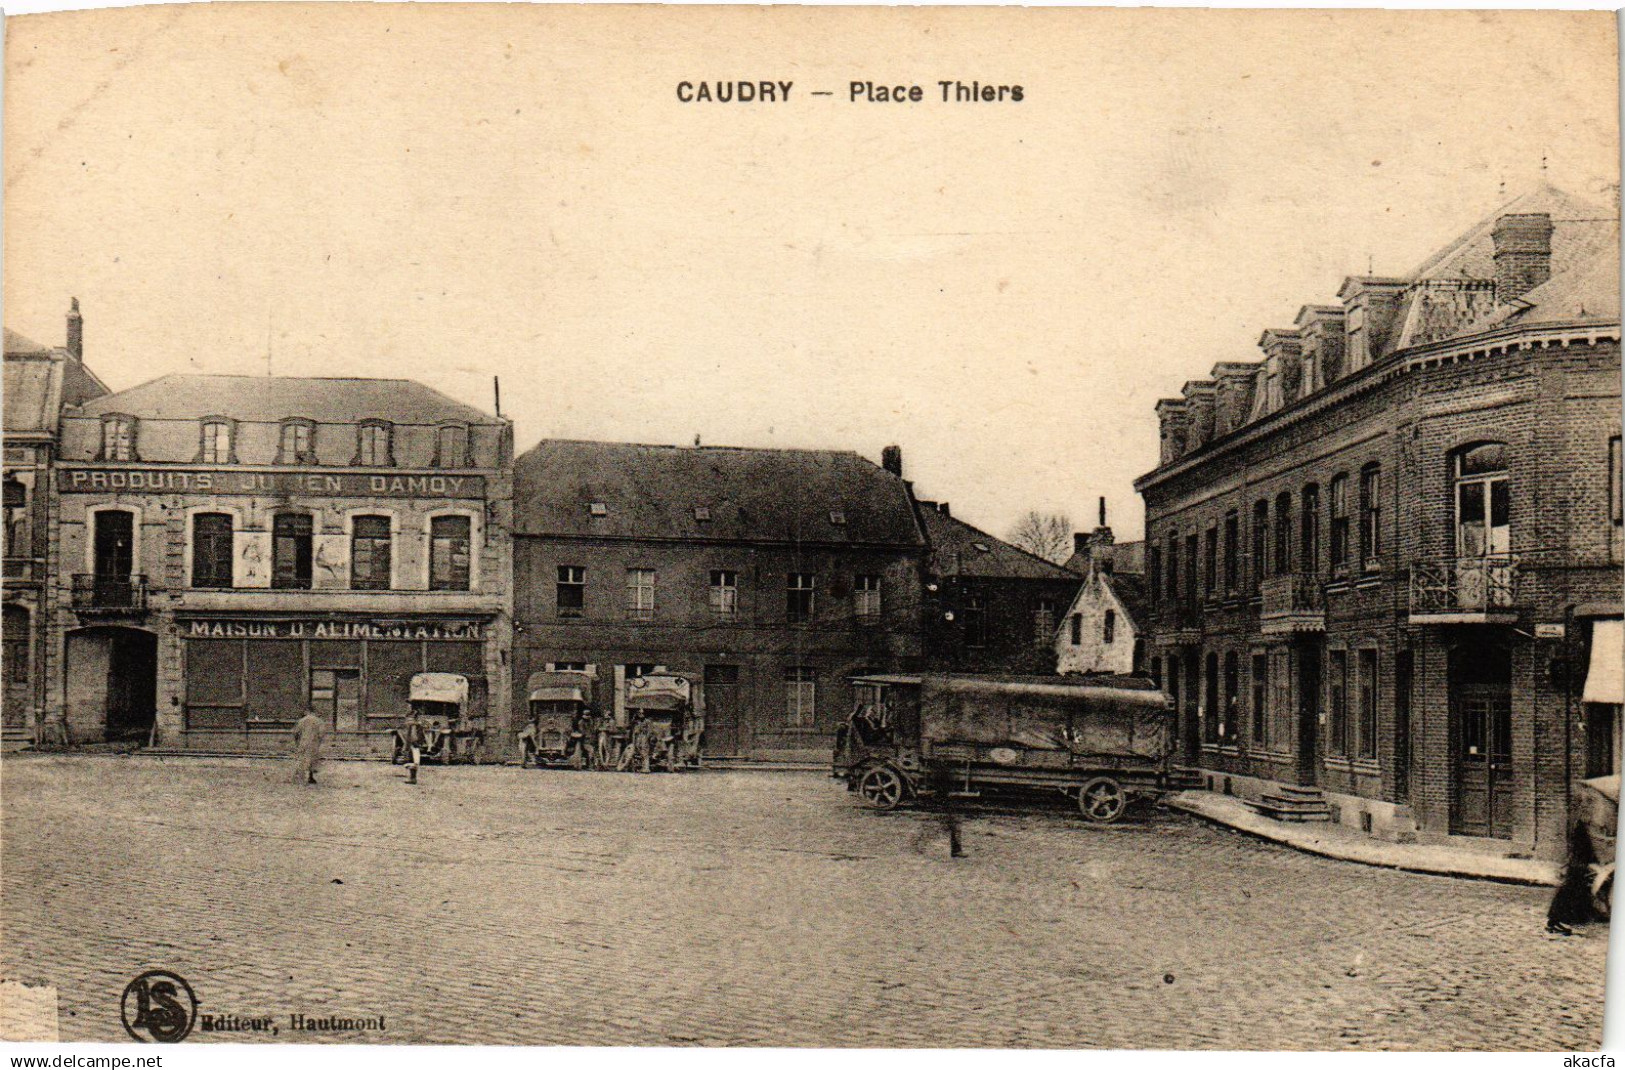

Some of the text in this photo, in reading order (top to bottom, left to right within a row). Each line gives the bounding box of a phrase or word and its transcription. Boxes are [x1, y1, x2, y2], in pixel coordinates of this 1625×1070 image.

[72, 470, 465, 493] PRODUITS JUIEN DAMOY
[189, 621, 277, 637] MAISON
